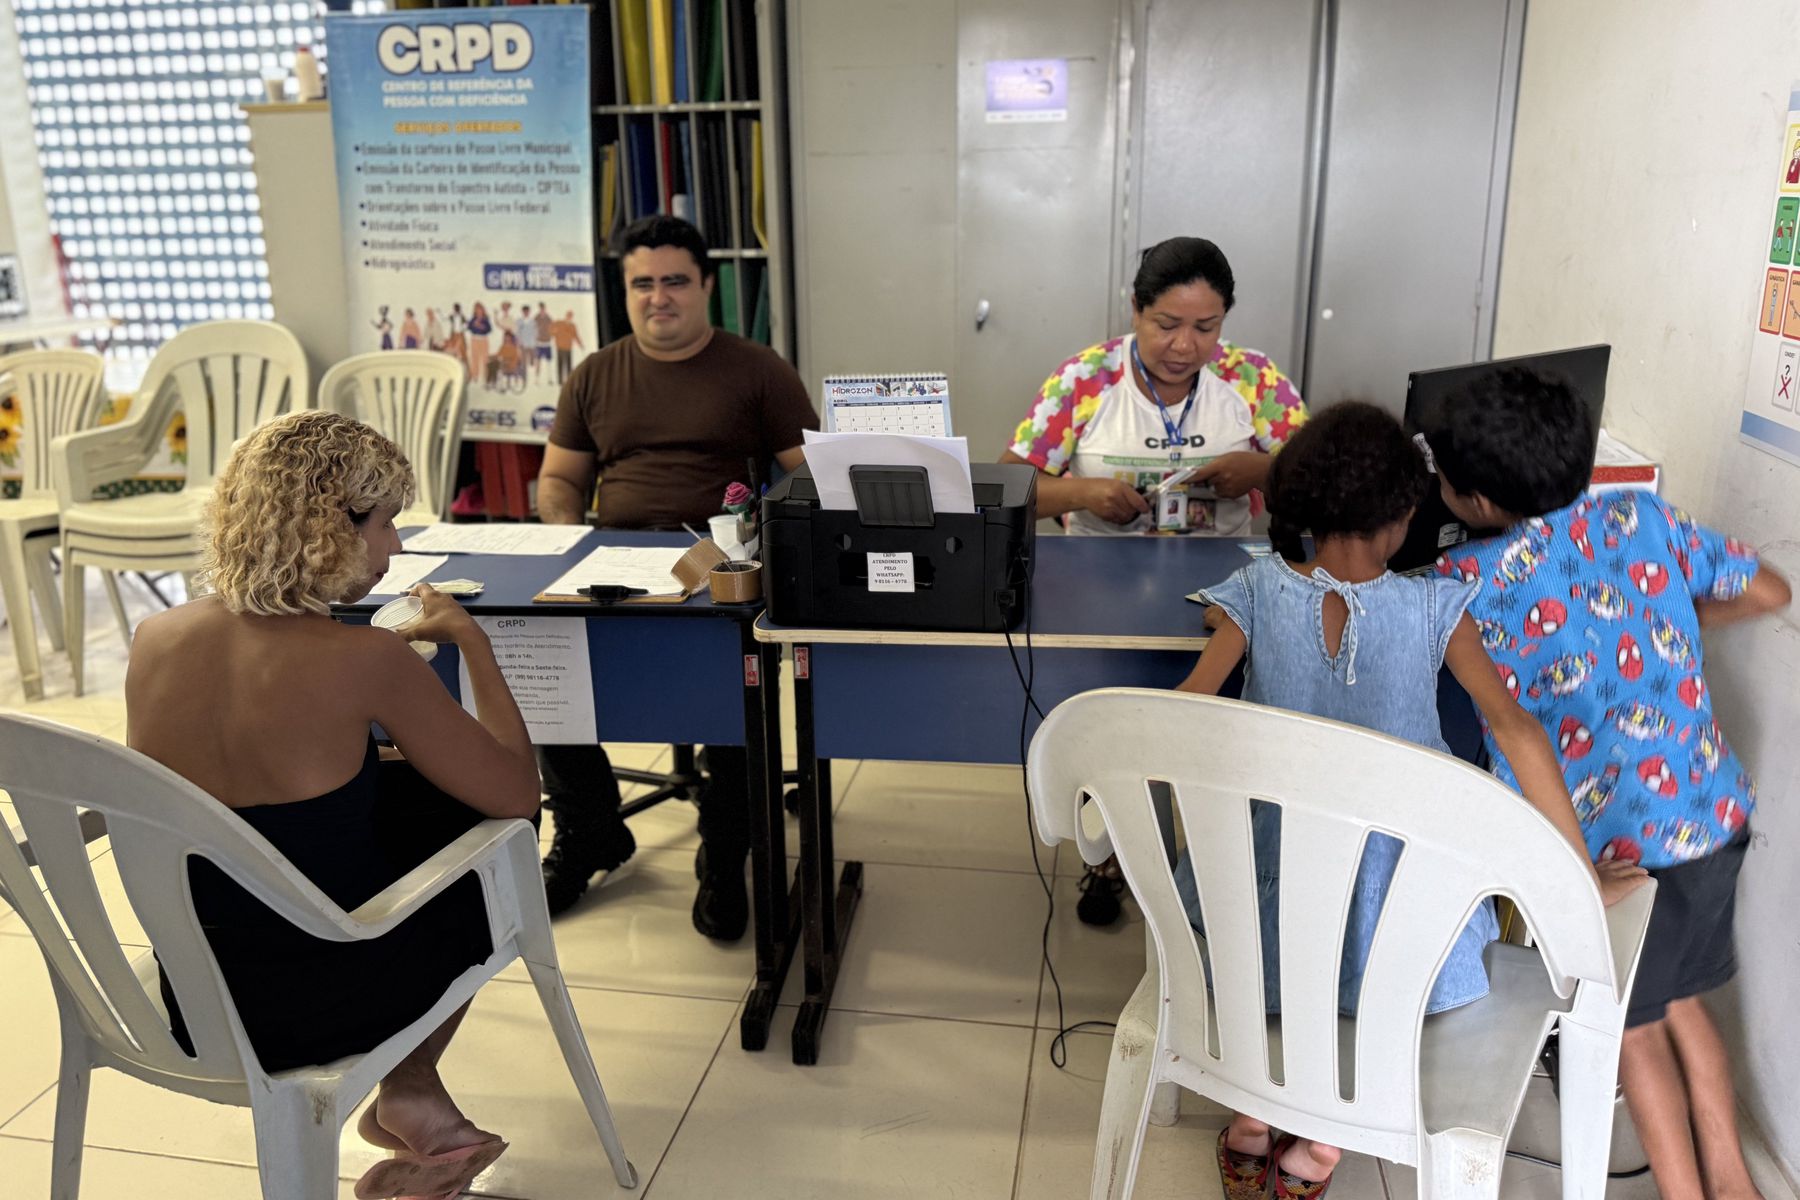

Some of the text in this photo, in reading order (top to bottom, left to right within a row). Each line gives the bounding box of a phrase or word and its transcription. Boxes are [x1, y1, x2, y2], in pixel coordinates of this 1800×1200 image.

[378, 22, 534, 74] CRPD
[382, 80, 427, 92] CENTRO
[430, 80, 444, 92] DE
[516, 78, 534, 90] DA
[383, 96, 427, 108] PESSOA
[429, 95, 456, 107] COM
[497, 620, 526, 628] CRPD
